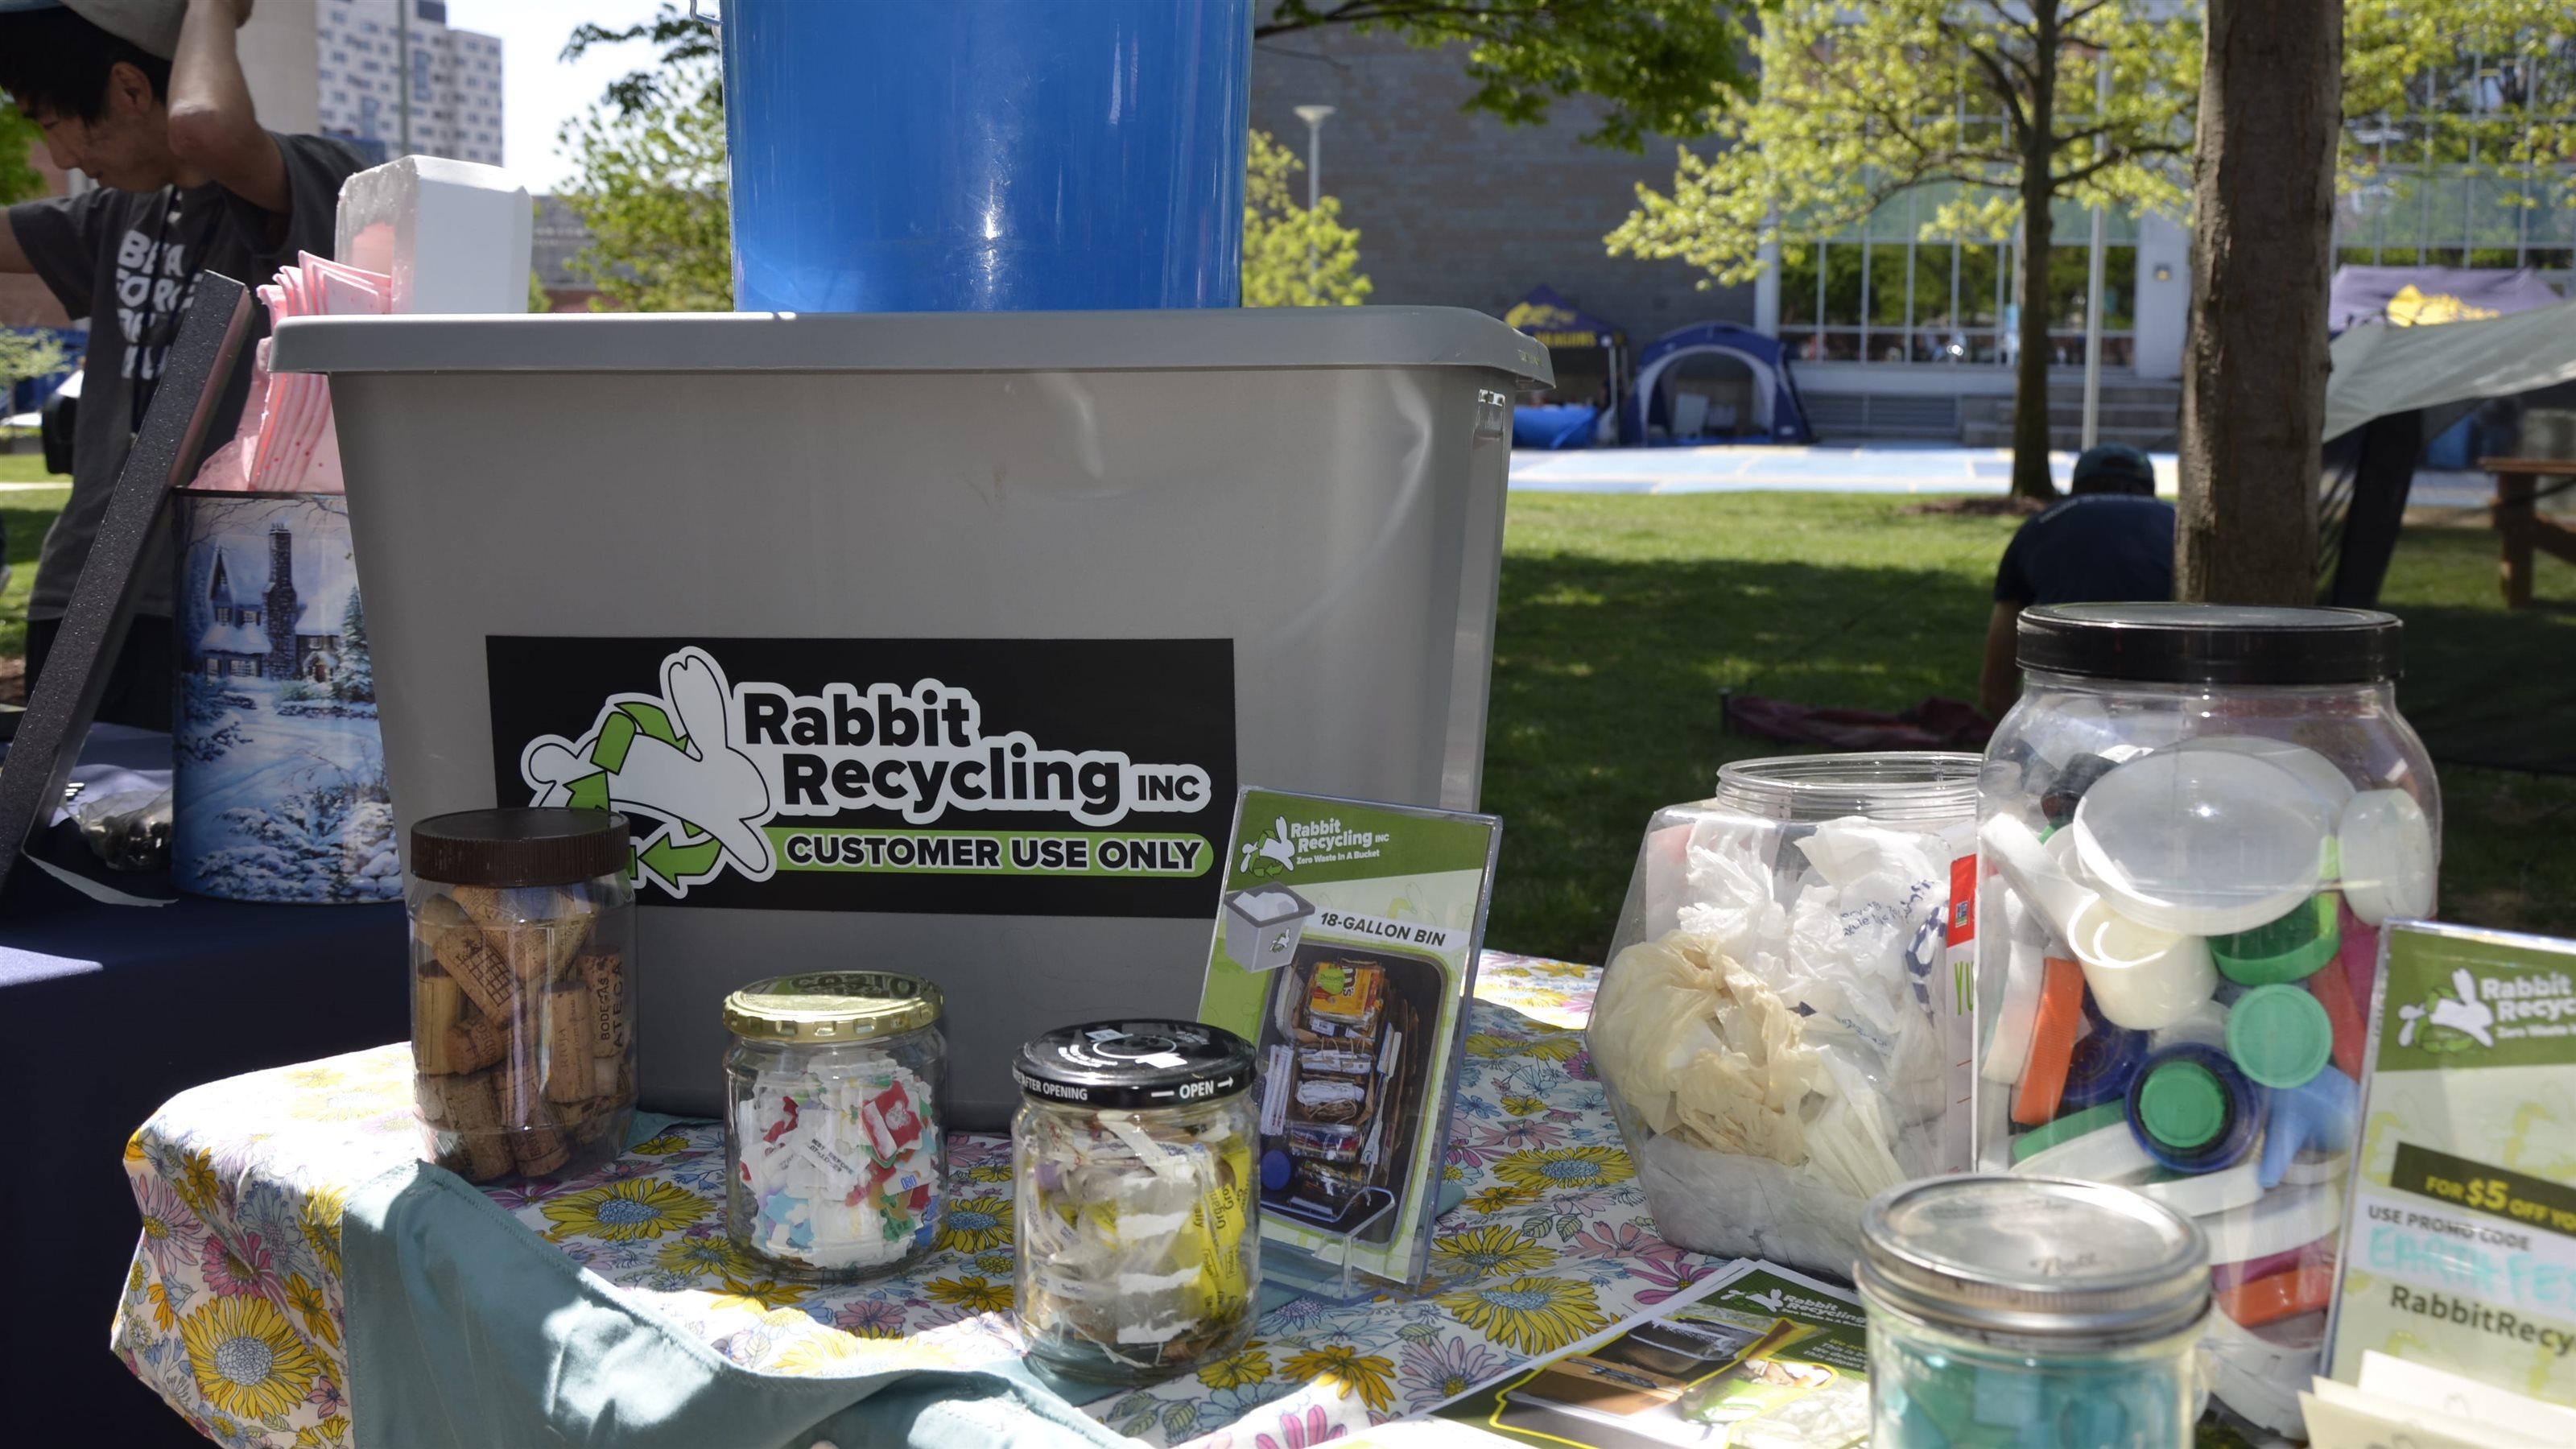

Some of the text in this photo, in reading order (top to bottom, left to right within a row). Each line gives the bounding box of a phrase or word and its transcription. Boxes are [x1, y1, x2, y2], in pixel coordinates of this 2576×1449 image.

[744, 689, 971, 747] Rabbit
[782, 742, 1199, 815] Recycling INC
[1291, 818, 1340, 837] Rabbit
[1298, 829, 1389, 852] Recycling INC
[786, 836, 1201, 869] CUSTOMER USE ONLY
[1297, 857, 1313, 865] Zero
[1314, 853, 1336, 863] Waste
[1347, 852, 1353, 860] A
[1353, 849, 1380, 859] Bucket
[1321, 912, 1446, 947] 18-GALLON BIN
[2481, 972, 2572, 999] Rabbit
[1021, 1072, 1042, 1092] AFTER
[1042, 1082, 1088, 1101] OPENING
[1179, 1080, 1214, 1099] OPEN
[2426, 1175, 2465, 1199] FOR
[2467, 1179, 2509, 1210] $5
[2509, 1199, 2549, 1221] OFF
[2369, 1206, 2529, 1250] USE PROMO CODE
[1783, 1294, 1838, 1311] Rabbit
[1786, 1302, 1868, 1323] Recycling
[2391, 1286, 2576, 1357] RabbitRecy
